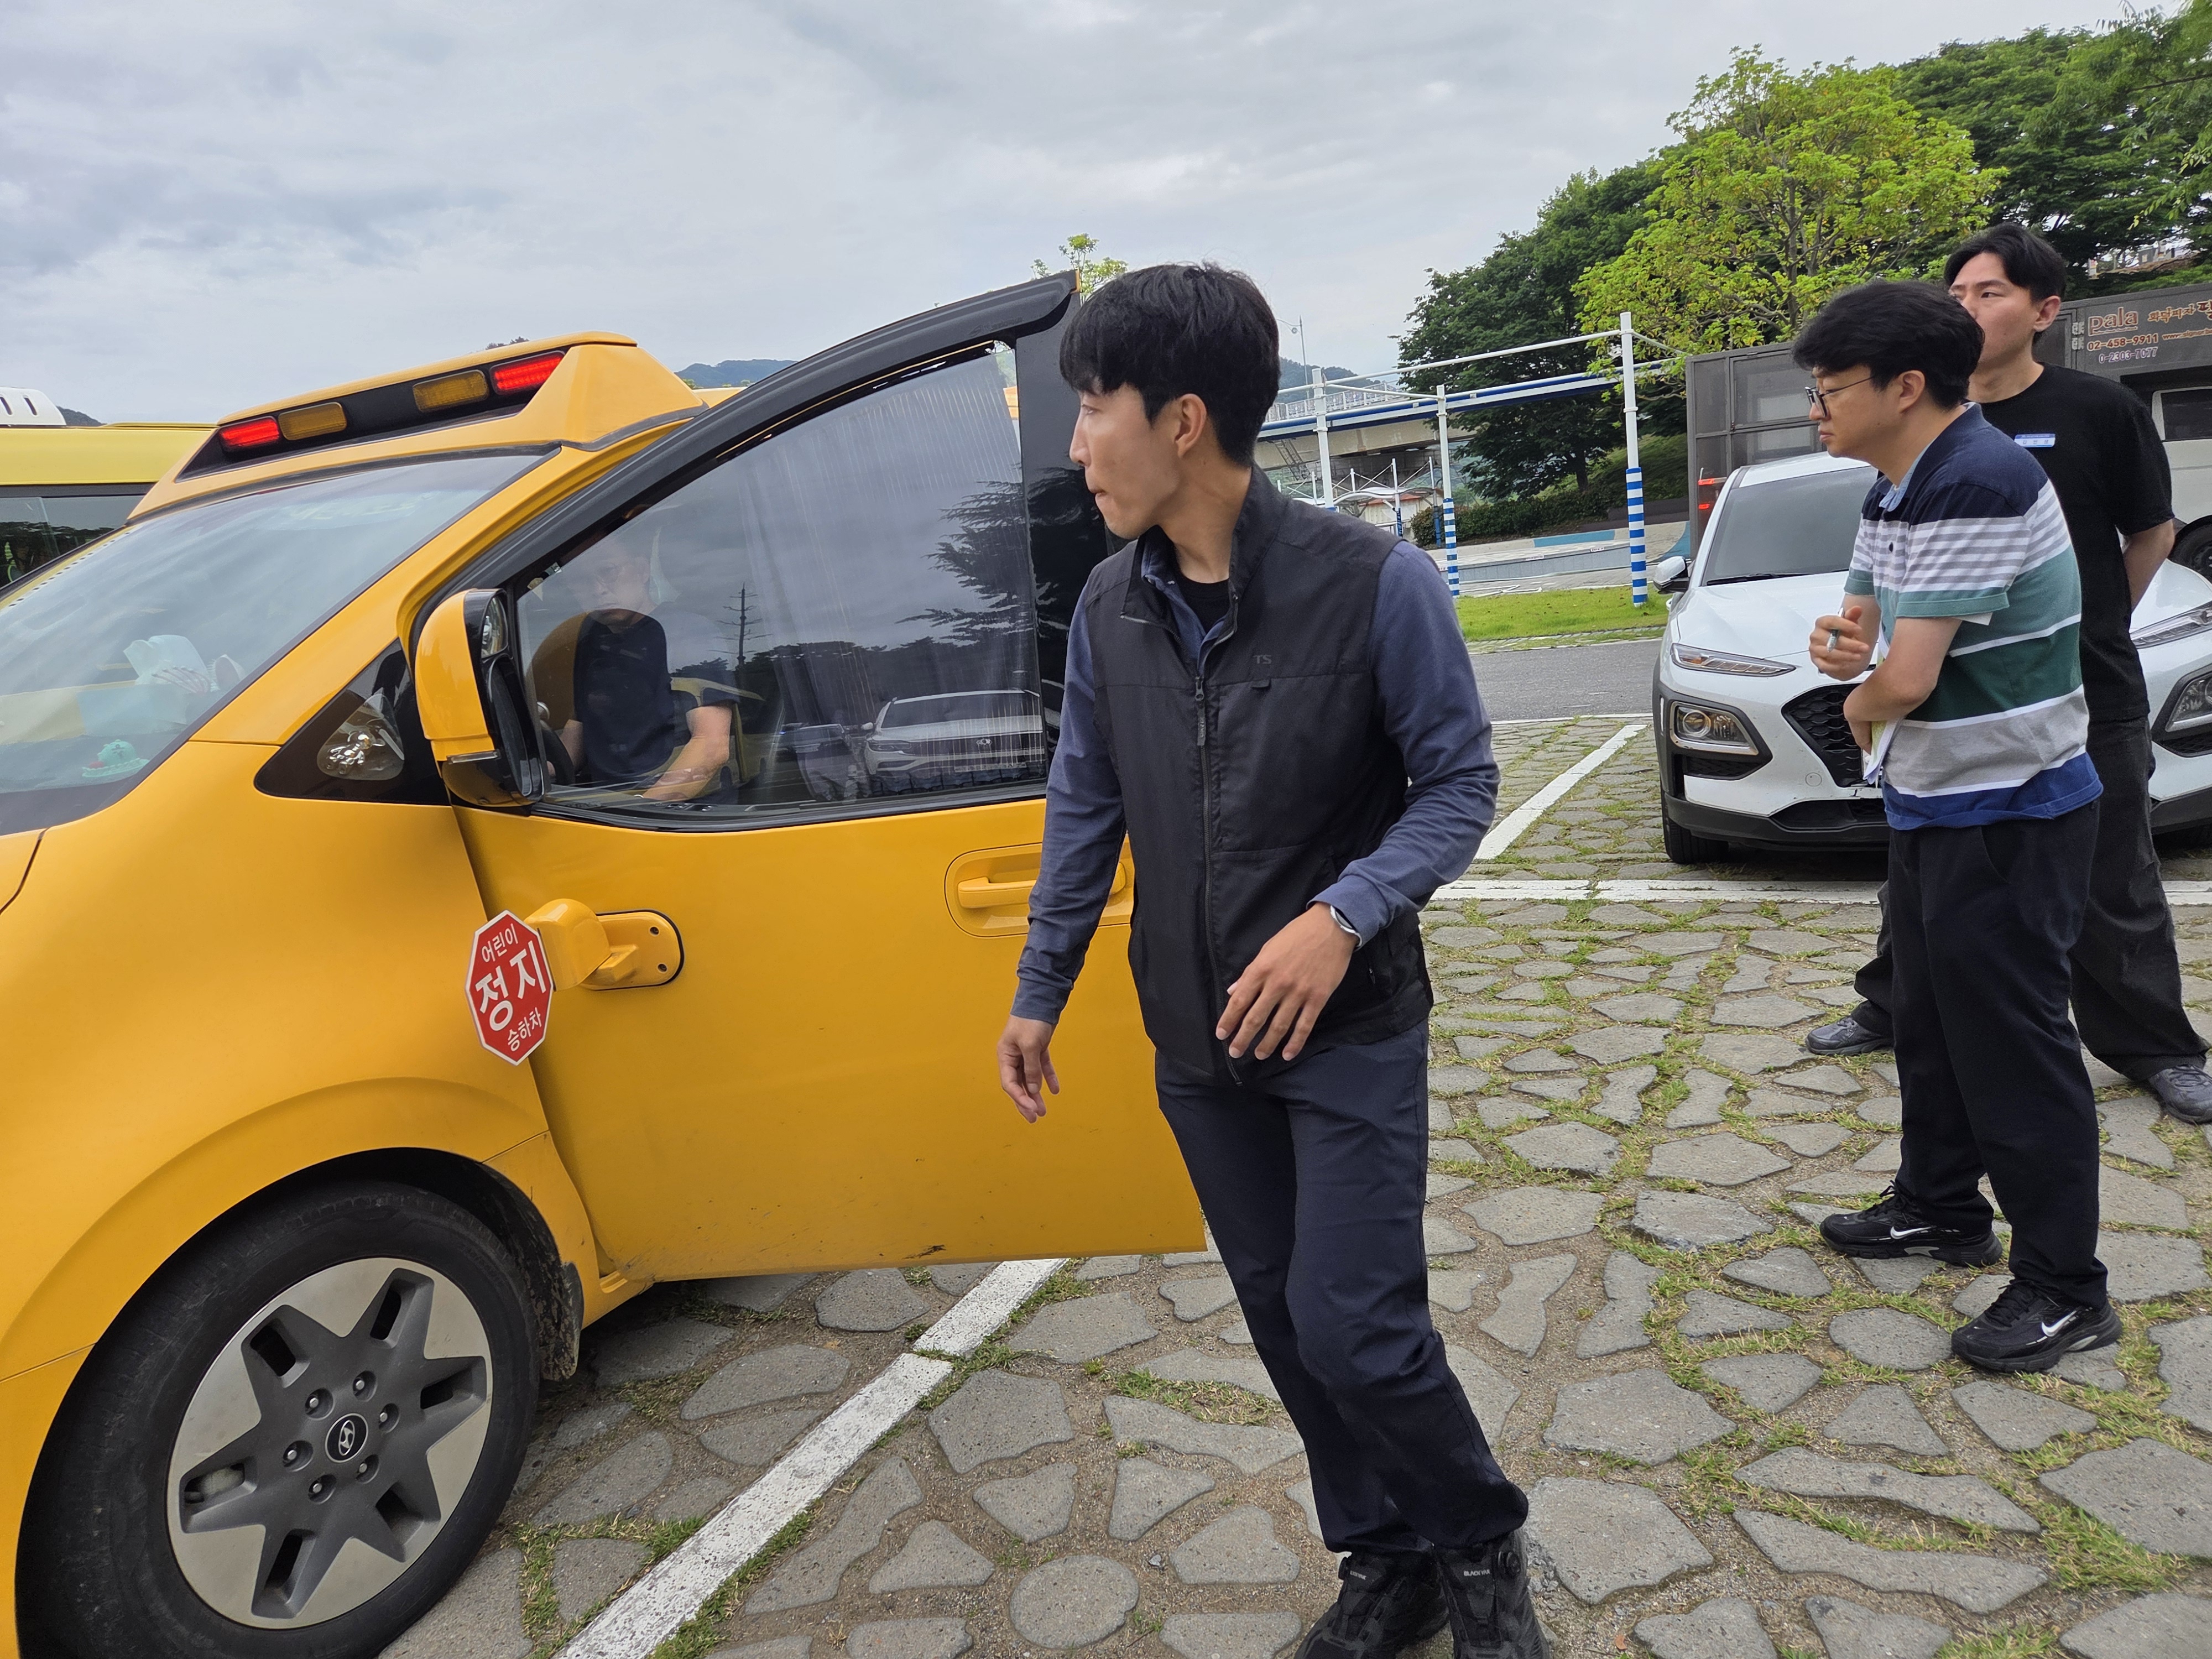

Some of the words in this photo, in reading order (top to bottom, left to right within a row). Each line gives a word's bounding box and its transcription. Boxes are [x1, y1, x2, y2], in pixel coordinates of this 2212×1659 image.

[2148, 303, 2196, 324] 화덕피자
[2087, 333, 2158, 352] 02-458-9911
[1252, 654, 1272, 664] TS
[482, 923, 519, 963] 어린이
[475, 940, 546, 1032] 정지
[508, 1006, 542, 1052] 승하차
